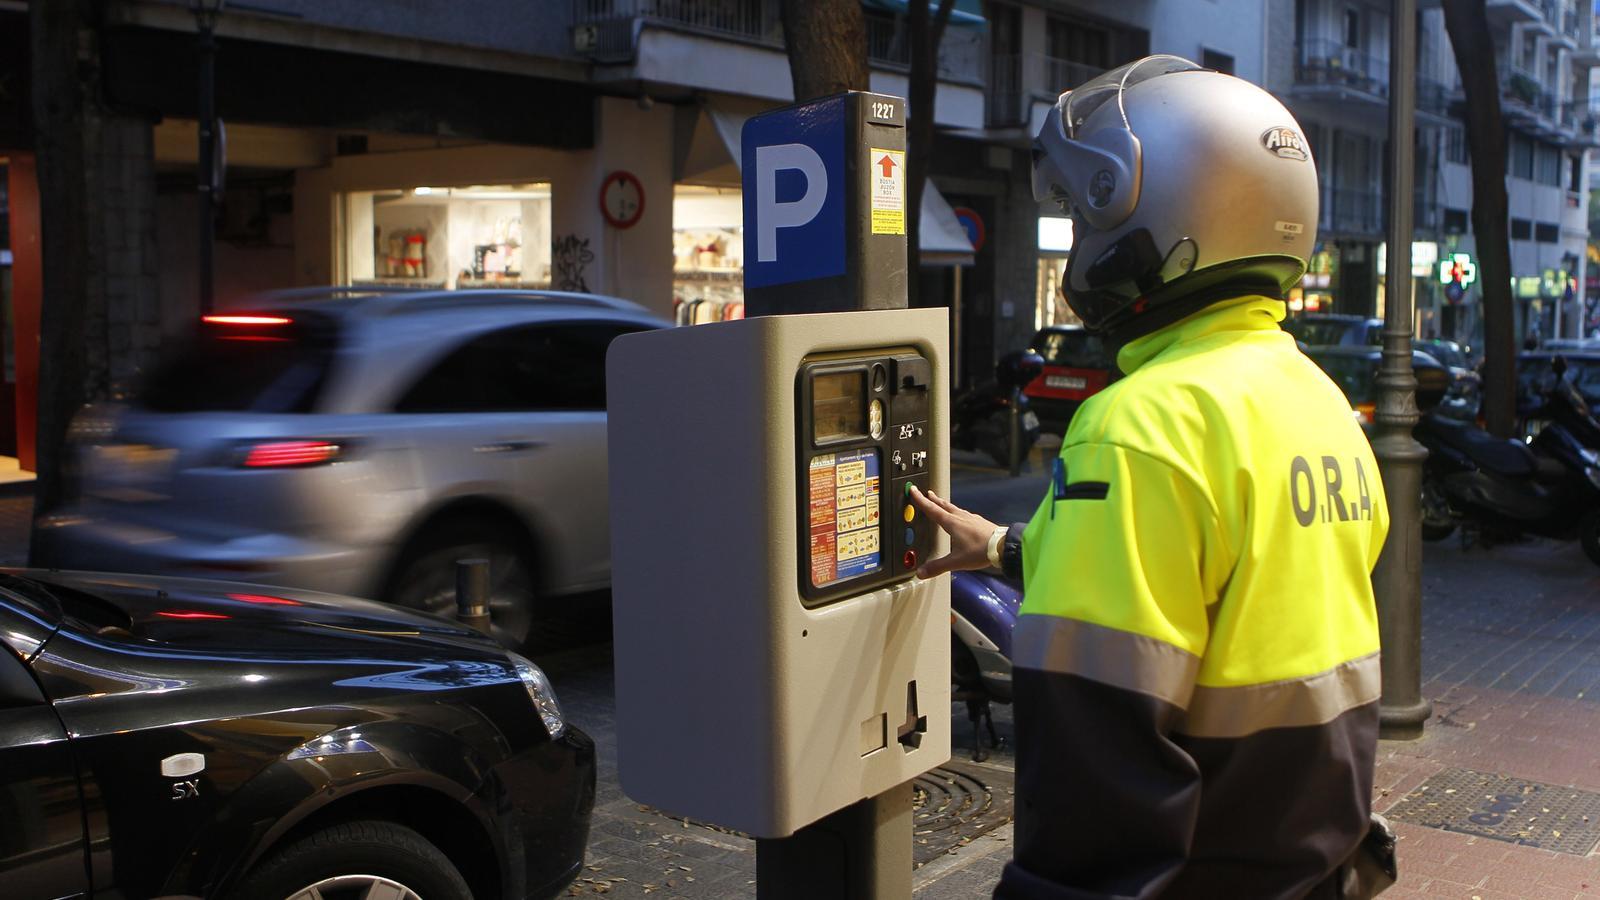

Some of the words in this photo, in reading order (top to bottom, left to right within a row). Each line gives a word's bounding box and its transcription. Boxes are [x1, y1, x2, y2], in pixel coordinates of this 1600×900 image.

[872, 102, 894, 119] 1227
[756, 143, 828, 262] P
[172, 779, 199, 800] SX
